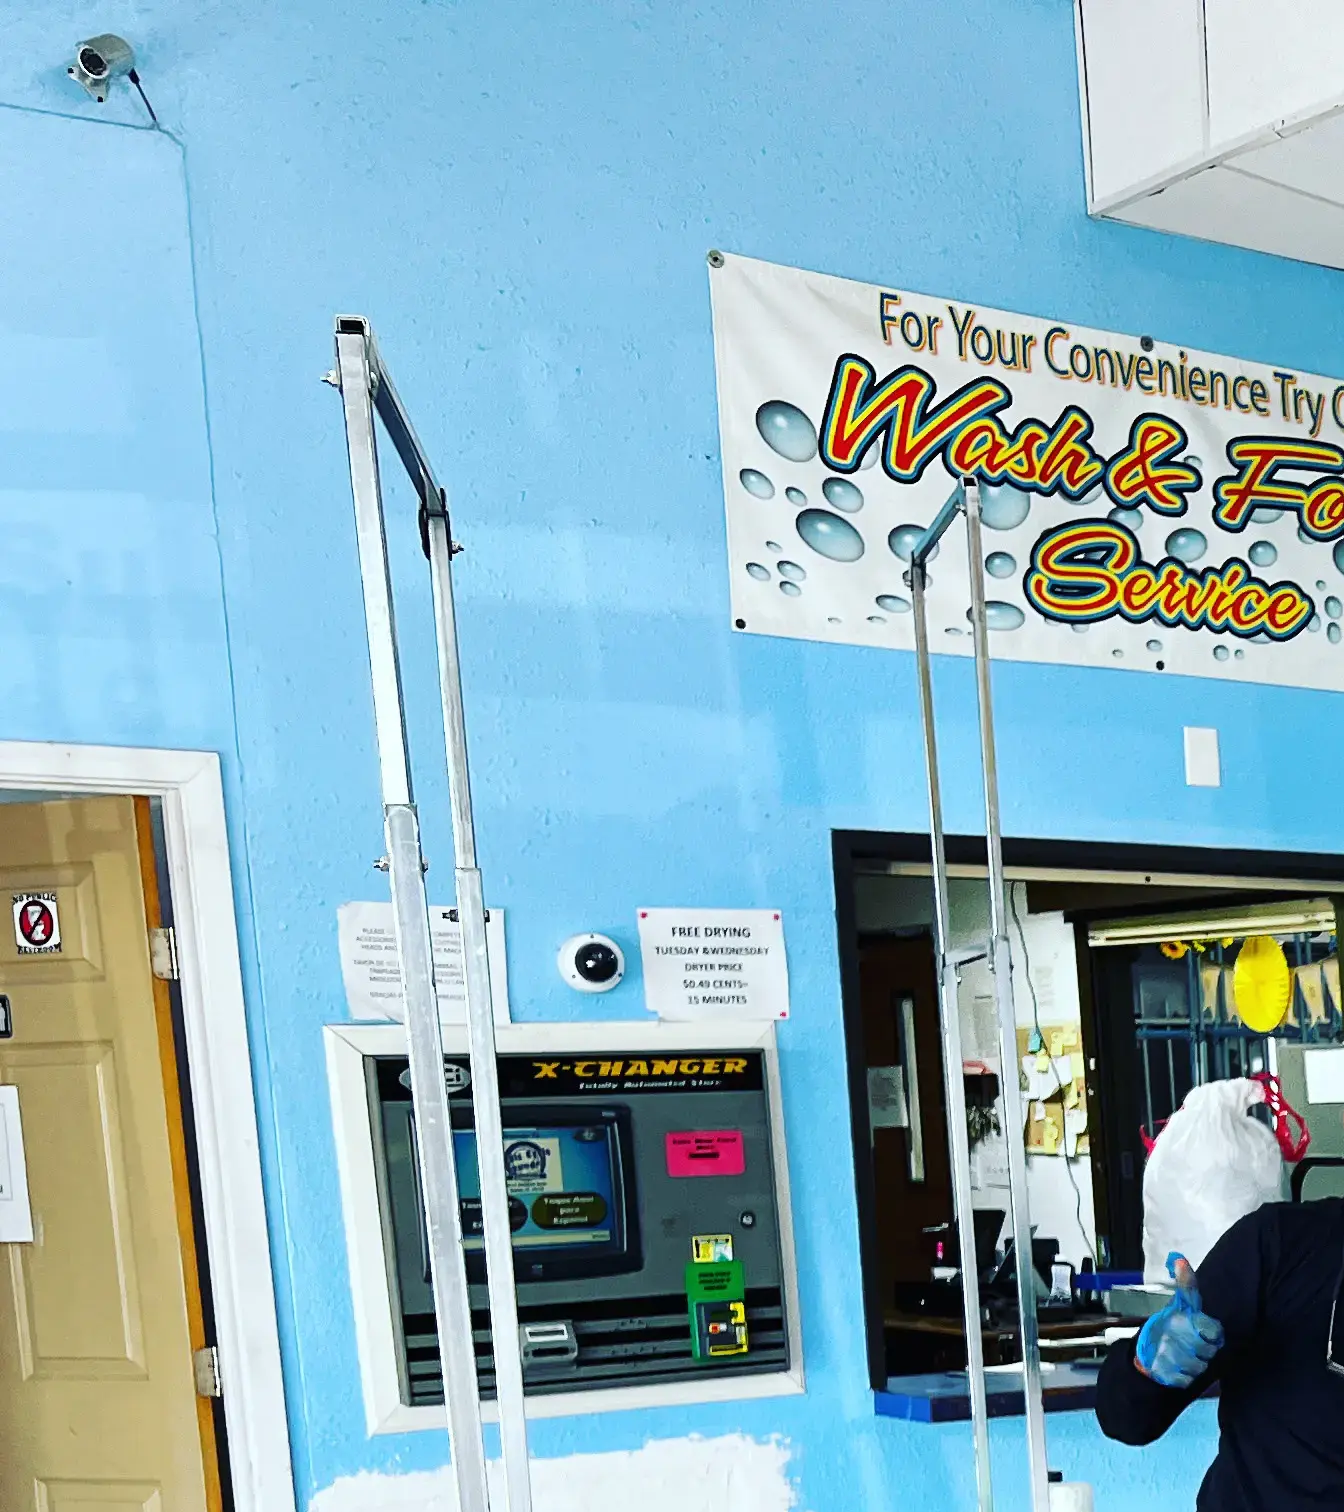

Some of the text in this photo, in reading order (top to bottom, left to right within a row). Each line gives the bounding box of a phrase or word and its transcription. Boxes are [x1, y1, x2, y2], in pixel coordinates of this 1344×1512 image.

[879, 291, 943, 355] For
[947, 304, 1036, 373] Your
[1043, 327, 1270, 417] Convenience
[1272, 370, 1327, 439] Try
[819, 354, 1106, 500] Wash
[1105, 412, 1203, 518] &
[1023, 517, 1316, 643] Service
[671, 926, 751, 938] FREE DRYING
[531, 1058, 748, 1079] X-CHANGER
